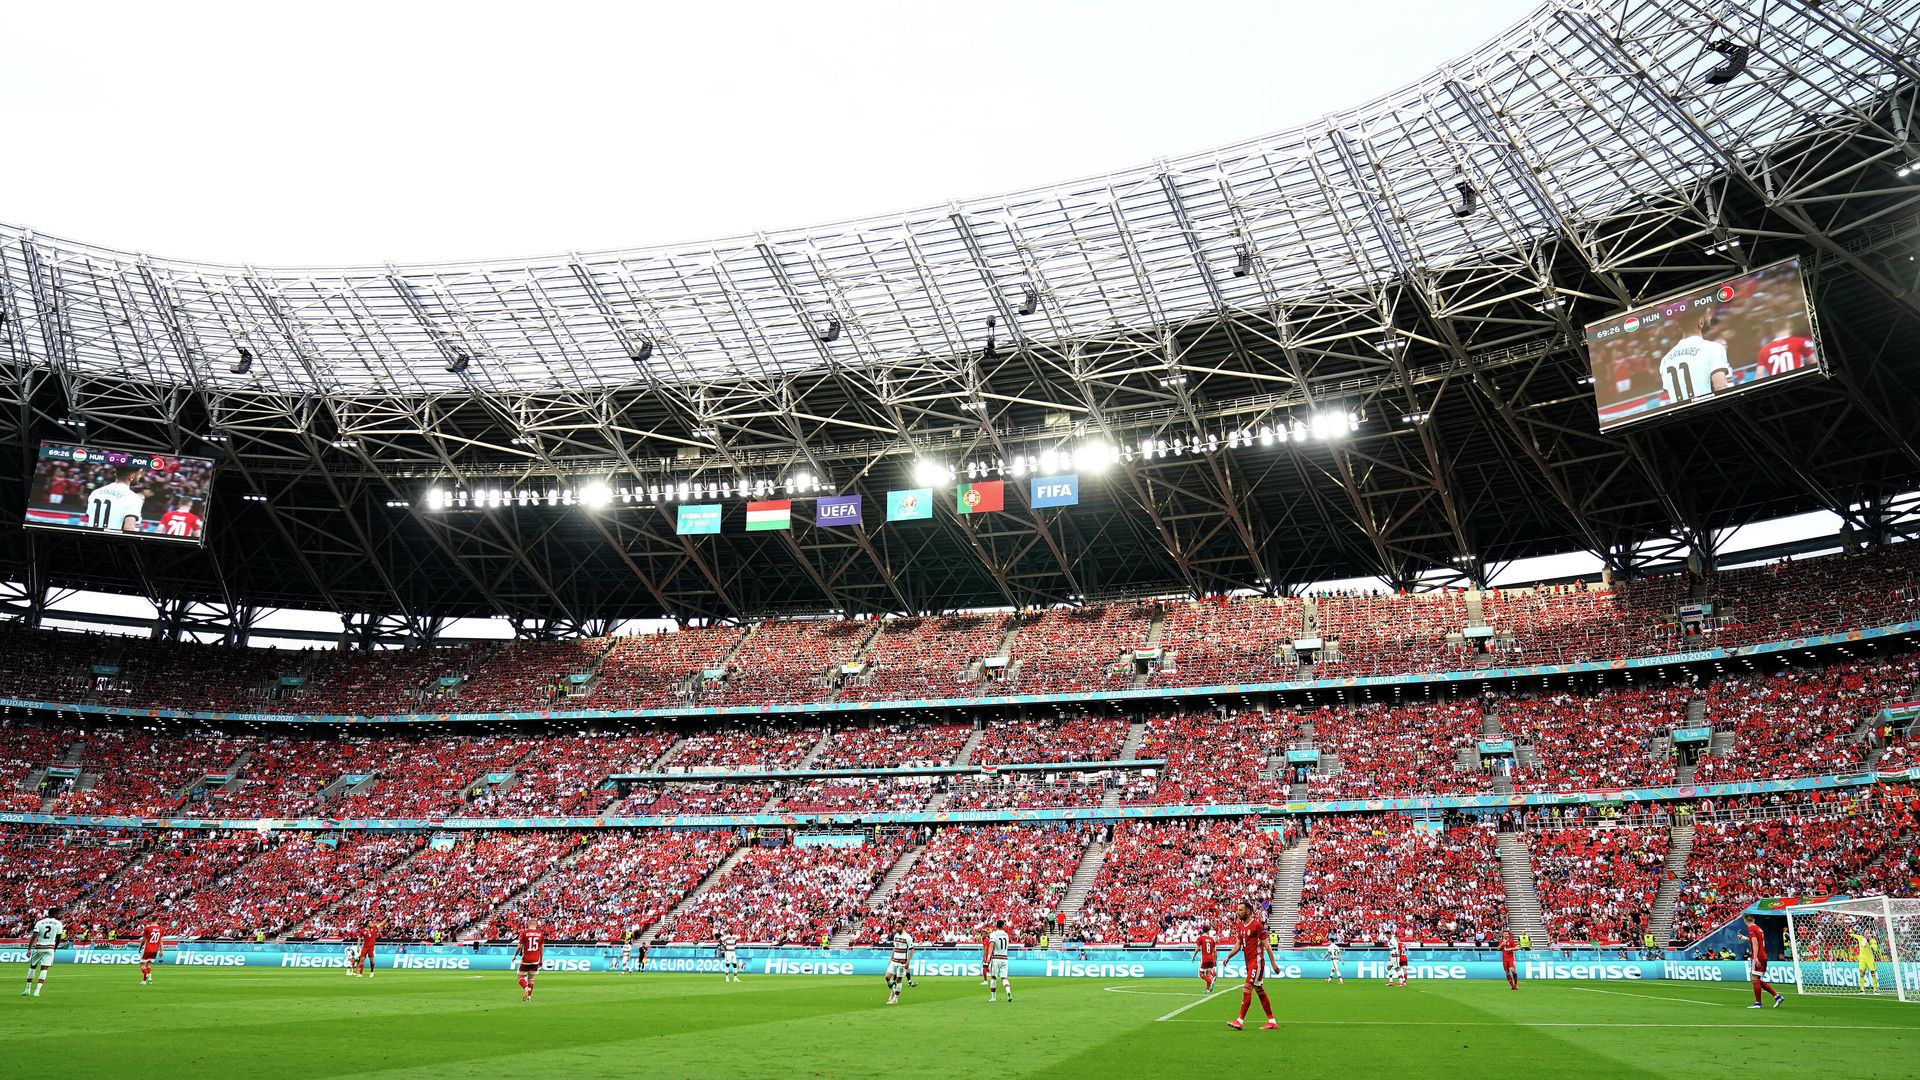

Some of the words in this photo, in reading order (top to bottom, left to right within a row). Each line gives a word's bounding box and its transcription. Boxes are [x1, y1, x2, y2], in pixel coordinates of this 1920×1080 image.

[1597, 326, 1621, 338] 69:26
[1642, 313, 1660, 325] HUN
[1694, 296, 1713, 308] POR
[1768, 351, 1795, 376] 20
[1667, 362, 1694, 402] 11
[48, 449, 70, 457] 69:26
[89, 453, 104, 461] HUN
[132, 458, 147, 466] POR
[1037, 484, 1072, 499] FIFA
[93, 499, 111, 528] 11
[821, 504, 856, 517] UEFA
[167, 520, 187, 536] 20
[1638, 658, 1661, 666] UEFA
[1662, 654, 1689, 663] EURO
[1689, 651, 1712, 660] 2020
[1367, 675, 1409, 685] BUDAPEST
[1, 698, 45, 709] BUDAPEST
[880, 700, 914, 708] BUDAPEST
[456, 713, 489, 721] BUDAPEST
[1537, 793, 1590, 803] BUDST
[958, 812, 1001, 821] BUDAPEST
[1218, 805, 1242, 814] UEFA
[683, 816, 723, 825] BUDAPEST
[43, 926, 51, 939] 2
[149, 931, 160, 944] 20
[527, 937, 539, 952] 15
[998, 937, 1007, 950] 11
[1206, 942, 1211, 954] 8
[74, 951, 141, 964] Hisense
[176, 951, 245, 966] Hisense
[393, 954, 470, 969] Hisense
[510, 956, 591, 971] Hense
[660, 958, 694, 971] EURO
[695, 958, 727, 972] 2020
[765, 958, 854, 974] Hisense
[908, 960, 983, 976] Hisens
[1046, 960, 1145, 978] Hisense
[1199, 961, 1301, 979] isese
[1251, 969, 1257, 978] 5
[1358, 961, 1467, 978] Hiense
[1525, 961, 1642, 979] Hisense
[1664, 961, 1722, 981] Hisense
[1744, 961, 1802, 984] Hsens
